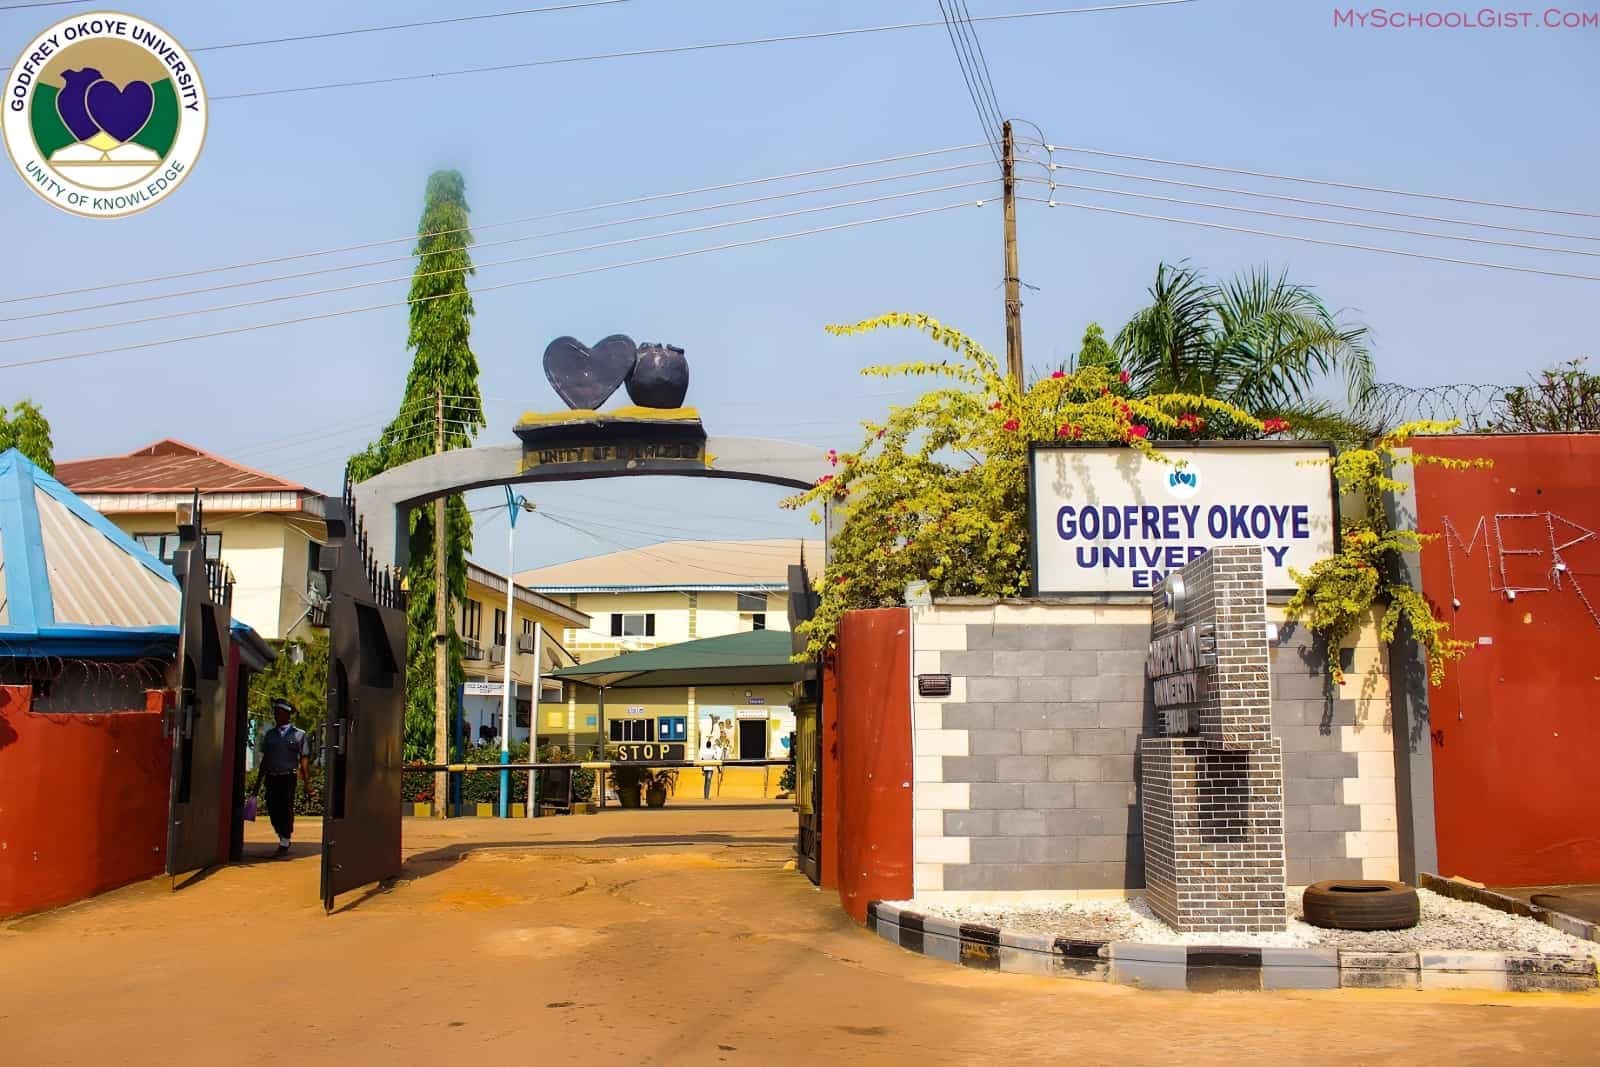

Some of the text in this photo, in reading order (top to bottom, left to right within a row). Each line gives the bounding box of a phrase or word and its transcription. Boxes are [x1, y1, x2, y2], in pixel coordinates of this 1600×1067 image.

[1056, 504, 1310, 541] GODFREY OKOYE
[1075, 545, 1290, 568] UNIVEY
[618, 743, 671, 761] STOP
